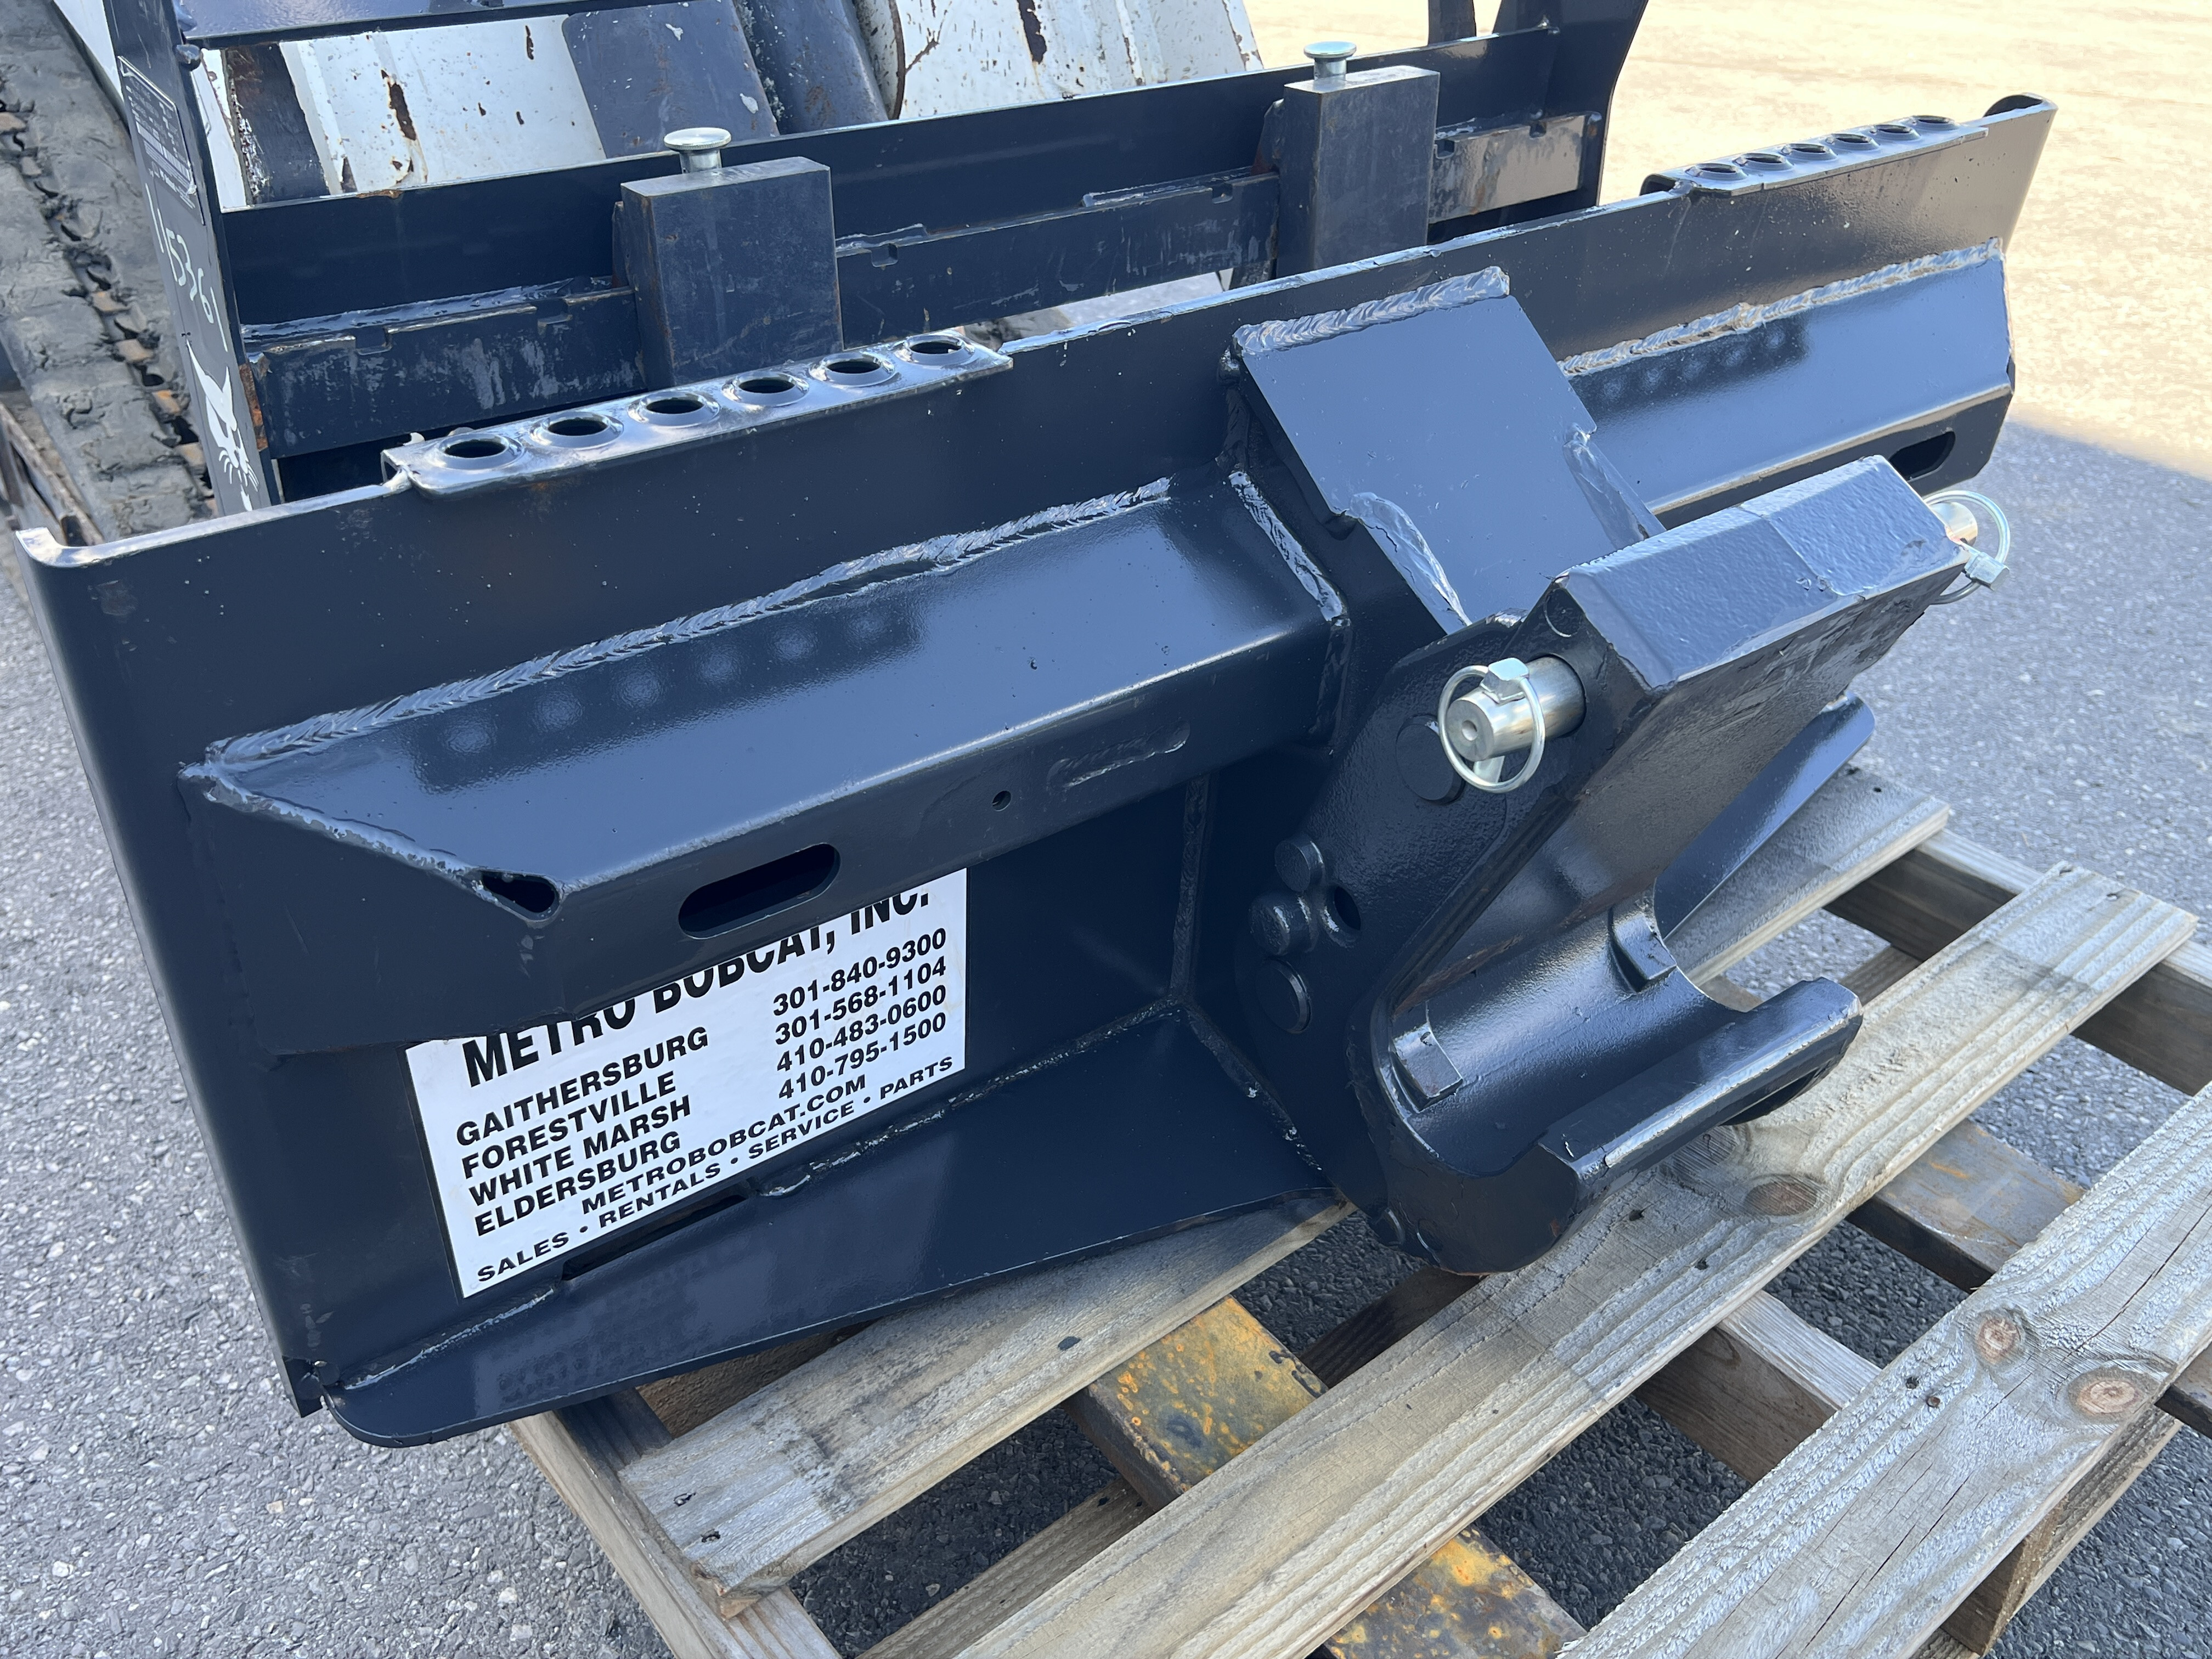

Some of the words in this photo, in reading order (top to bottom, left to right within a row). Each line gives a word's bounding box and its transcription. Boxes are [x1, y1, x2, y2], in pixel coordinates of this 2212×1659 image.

[457, 1027, 708, 1146] GAITHERSBURG
[774, 928, 945, 1015] 301-840-9300
[462, 998, 635, 1087] METRO
[462, 1071, 675, 1179] FORESTVILLE
[776, 956, 945, 1045] 301-568-1104
[469, 1146, 574, 1206] WHITE
[583, 1095, 690, 1159] MARSH
[777, 985, 945, 1071] 410-483-0600
[475, 1132, 680, 1236] ELDERSBURG
[779, 1013, 945, 1098] 410-795-1500
[582, 1075, 865, 1214] METROBOBCAT.COM
[478, 1232, 568, 1281] SALES
[599, 1163, 720, 1228] RENTALS
[748, 1100, 854, 1159] SERVICE
[881, 1057, 952, 1099] PARTS
